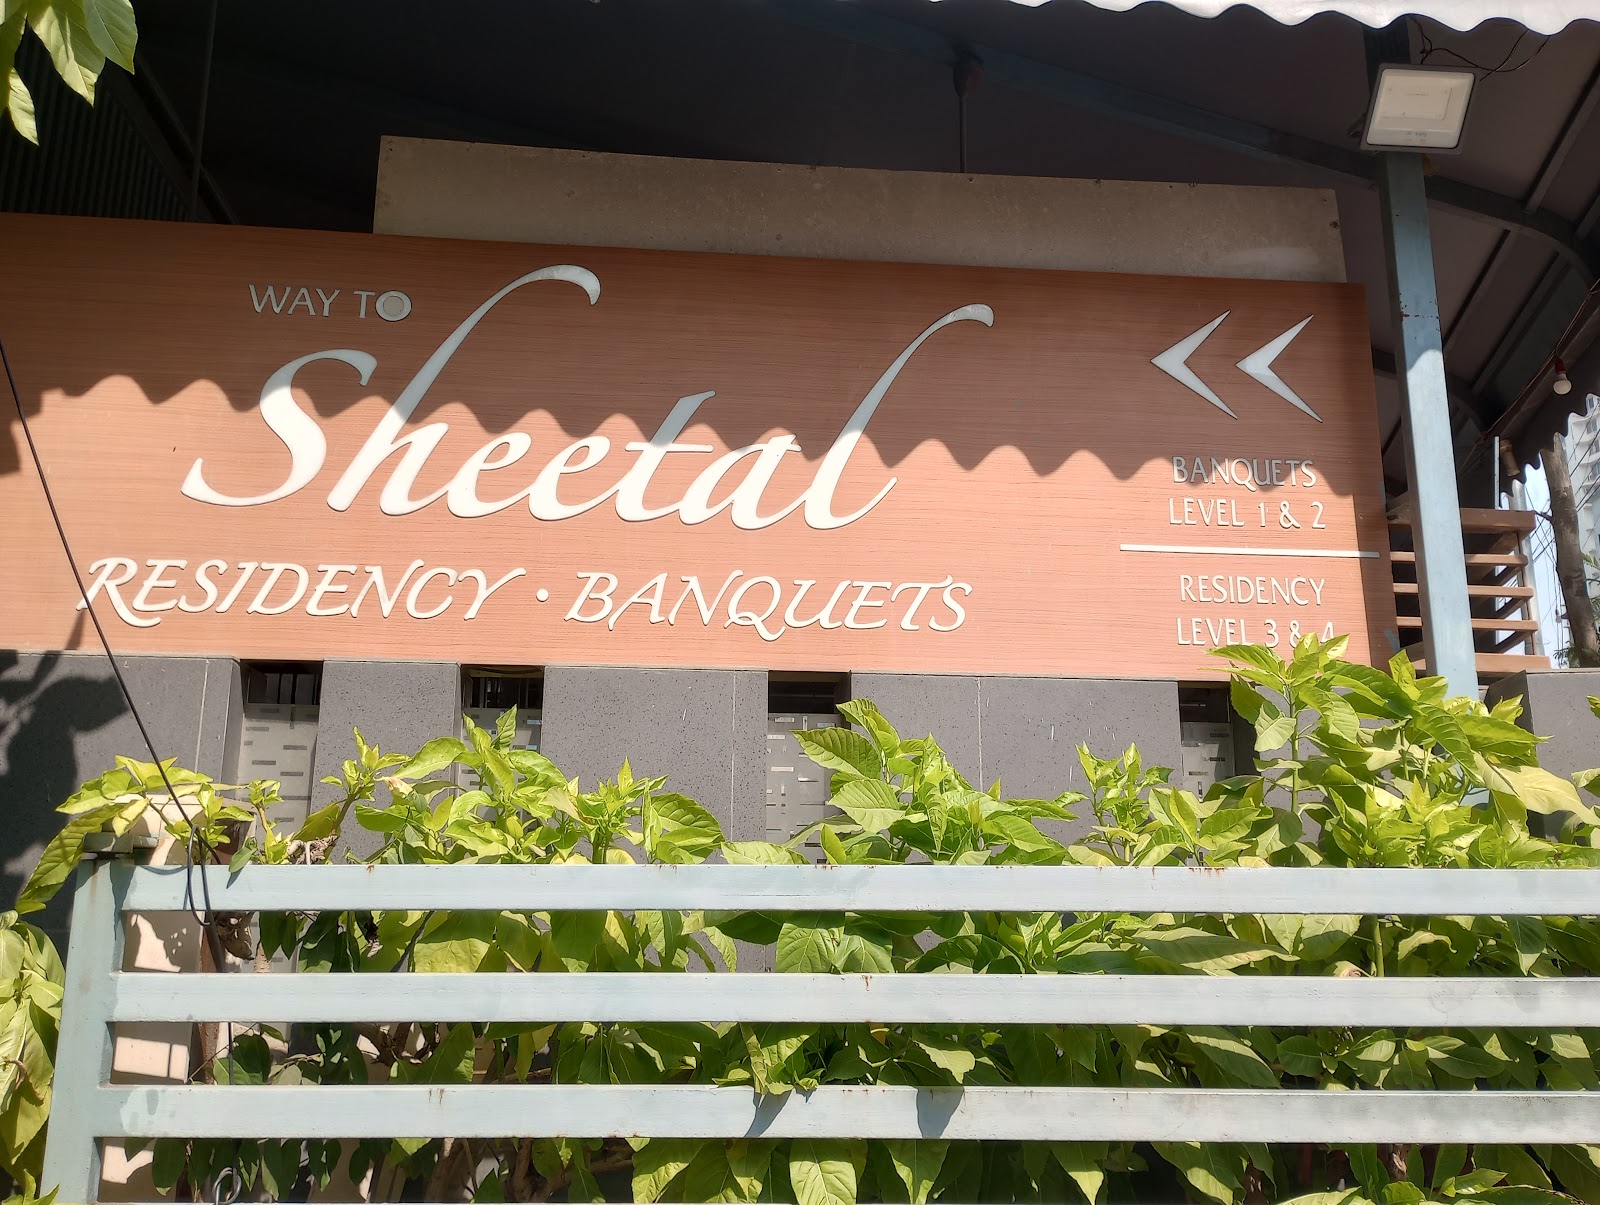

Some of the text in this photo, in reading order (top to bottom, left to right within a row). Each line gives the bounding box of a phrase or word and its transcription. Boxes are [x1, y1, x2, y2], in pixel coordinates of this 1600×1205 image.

[249, 284, 412, 321] WAY TO
[180, 264, 995, 530] Sheetal
[1171, 456, 1317, 492] BANQUETS
[1168, 497, 1327, 530] LEVEL 1 & 2
[76, 556, 973, 642] RESIDENCY BANQUETS
[1179, 574, 1326, 606] RESIDENCY
[1176, 617, 1254, 647] LEVEL
[1263, 618, 1280, 649] 3
